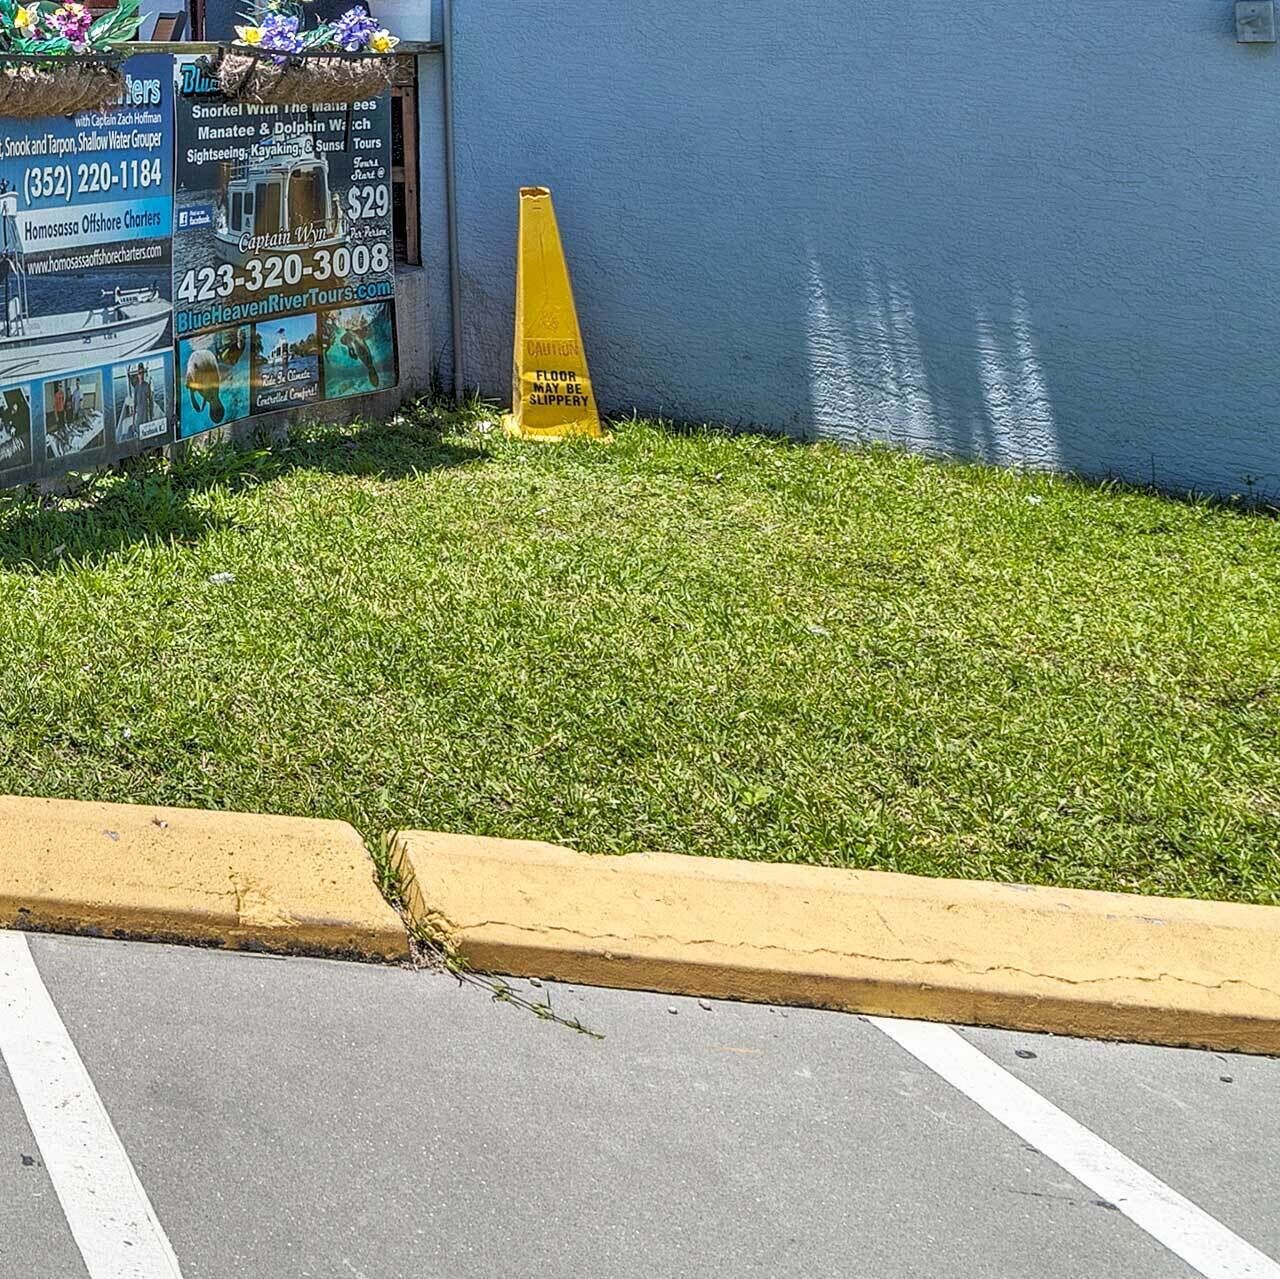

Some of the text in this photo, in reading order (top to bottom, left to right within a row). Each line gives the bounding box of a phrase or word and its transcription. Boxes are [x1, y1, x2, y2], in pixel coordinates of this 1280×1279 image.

[75, 111, 162, 129] with Captain Zach Hoffman
[192, 103, 242, 118] Snorkel
[312, 100, 377, 112] Manaees
[198, 118, 371, 140] Manatee & Dolphin Wach
[5, 136, 32, 157] Snook
[32, 134, 47, 154] and
[48, 135, 78, 159] Tarpon,
[78, 132, 109, 152] Shallow
[109, 131, 131, 149] Water
[131, 130, 162, 153] Grouper
[186, 137, 382, 165] Sightseeing, Kayaking, & Sunse Tours
[24, 158, 162, 205] (352) 220-1184
[347, 184, 389, 220] $29
[24, 209, 161, 241] Homosassa Offshore Charters
[238, 223, 327, 255] Captain Wyn
[27, 244, 162, 275] www.homosassaoffshorecharters.com
[177, 243, 389, 303] 423-320-3008
[177, 281, 391, 333] BlueHeavenRiverTours.com
[526, 341, 579, 357] CAUTION
[533, 383, 582, 395] MAY BE
[536, 370, 576, 382] FLOOR
[528, 394, 589, 407] SLIPPERY
